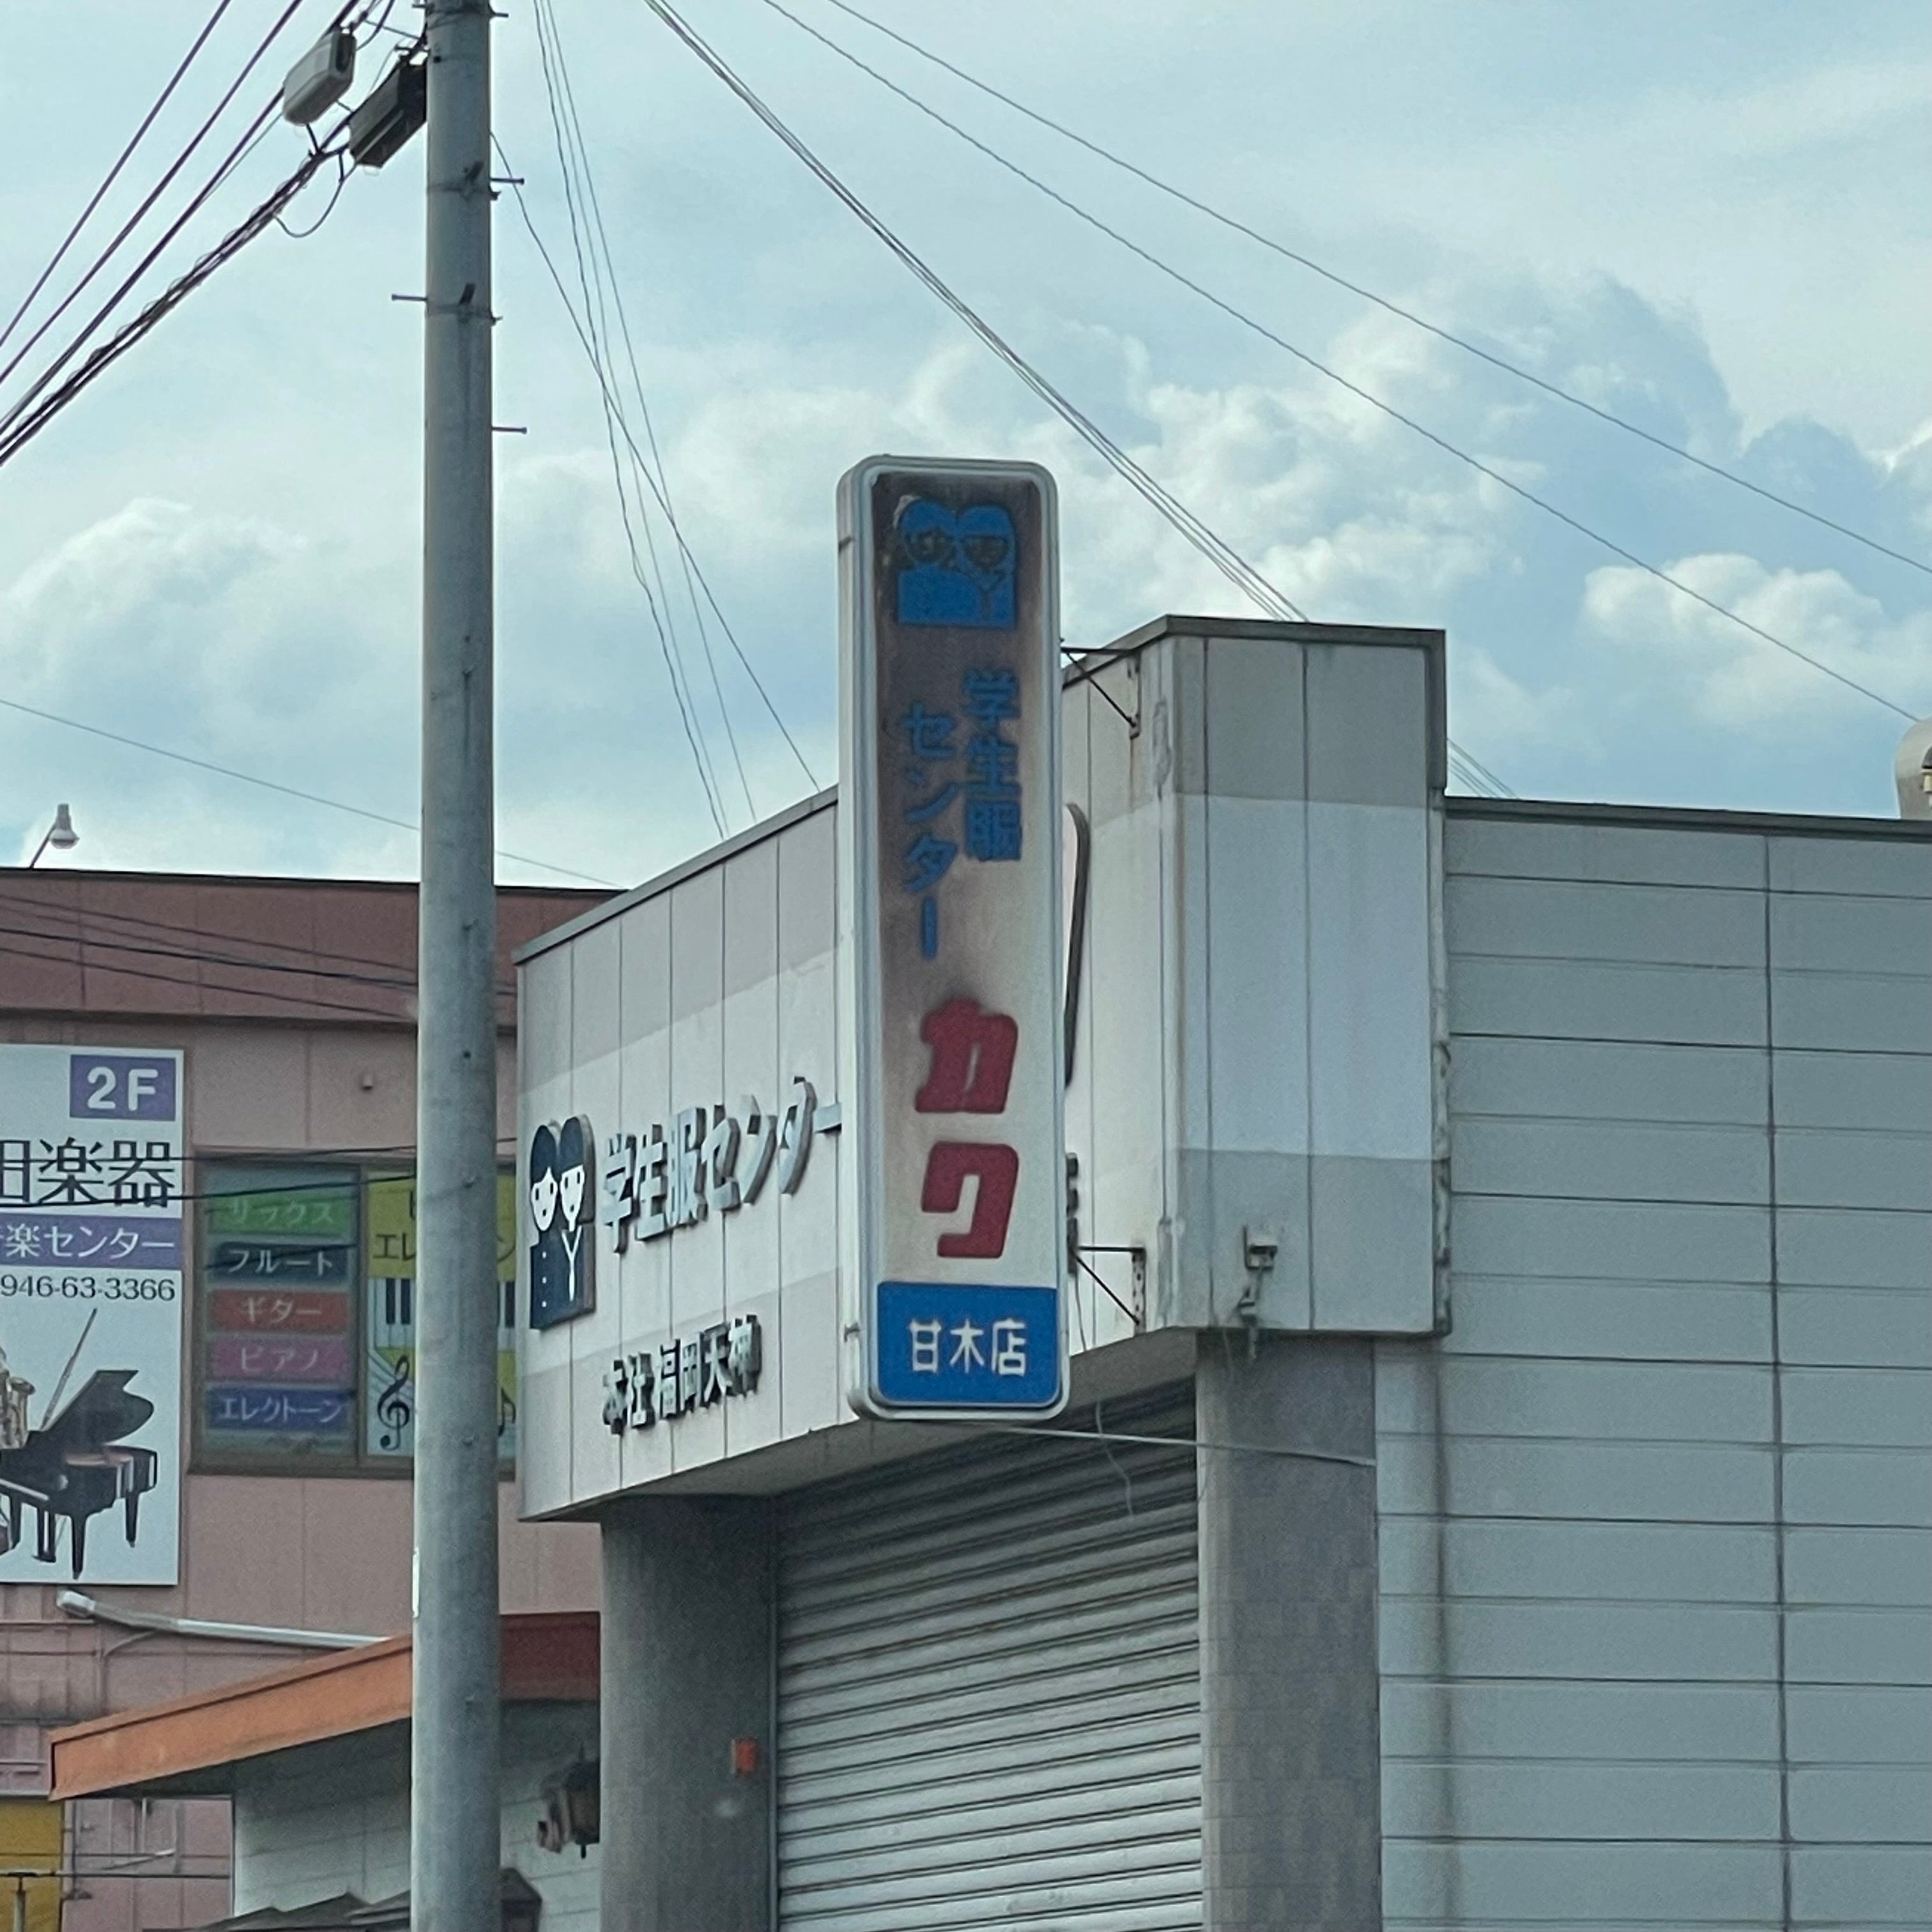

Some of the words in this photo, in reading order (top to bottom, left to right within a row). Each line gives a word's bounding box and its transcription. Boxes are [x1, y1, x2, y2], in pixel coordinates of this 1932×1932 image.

[901, 702, 958, 960] センター
[86, 1066, 159, 1111] 2F
[915, 998, 1019, 1259] カク
[598, 1076, 842, 1254] 学生服センター
[0, 1223, 174, 1259] 楽センター
[227, 1250, 333, 1275] フルート
[240, 1298, 322, 1324] ギター
[909, 1318, 1027, 1377] 甘木店
[219, 1397, 343, 1423] エレクトーン
